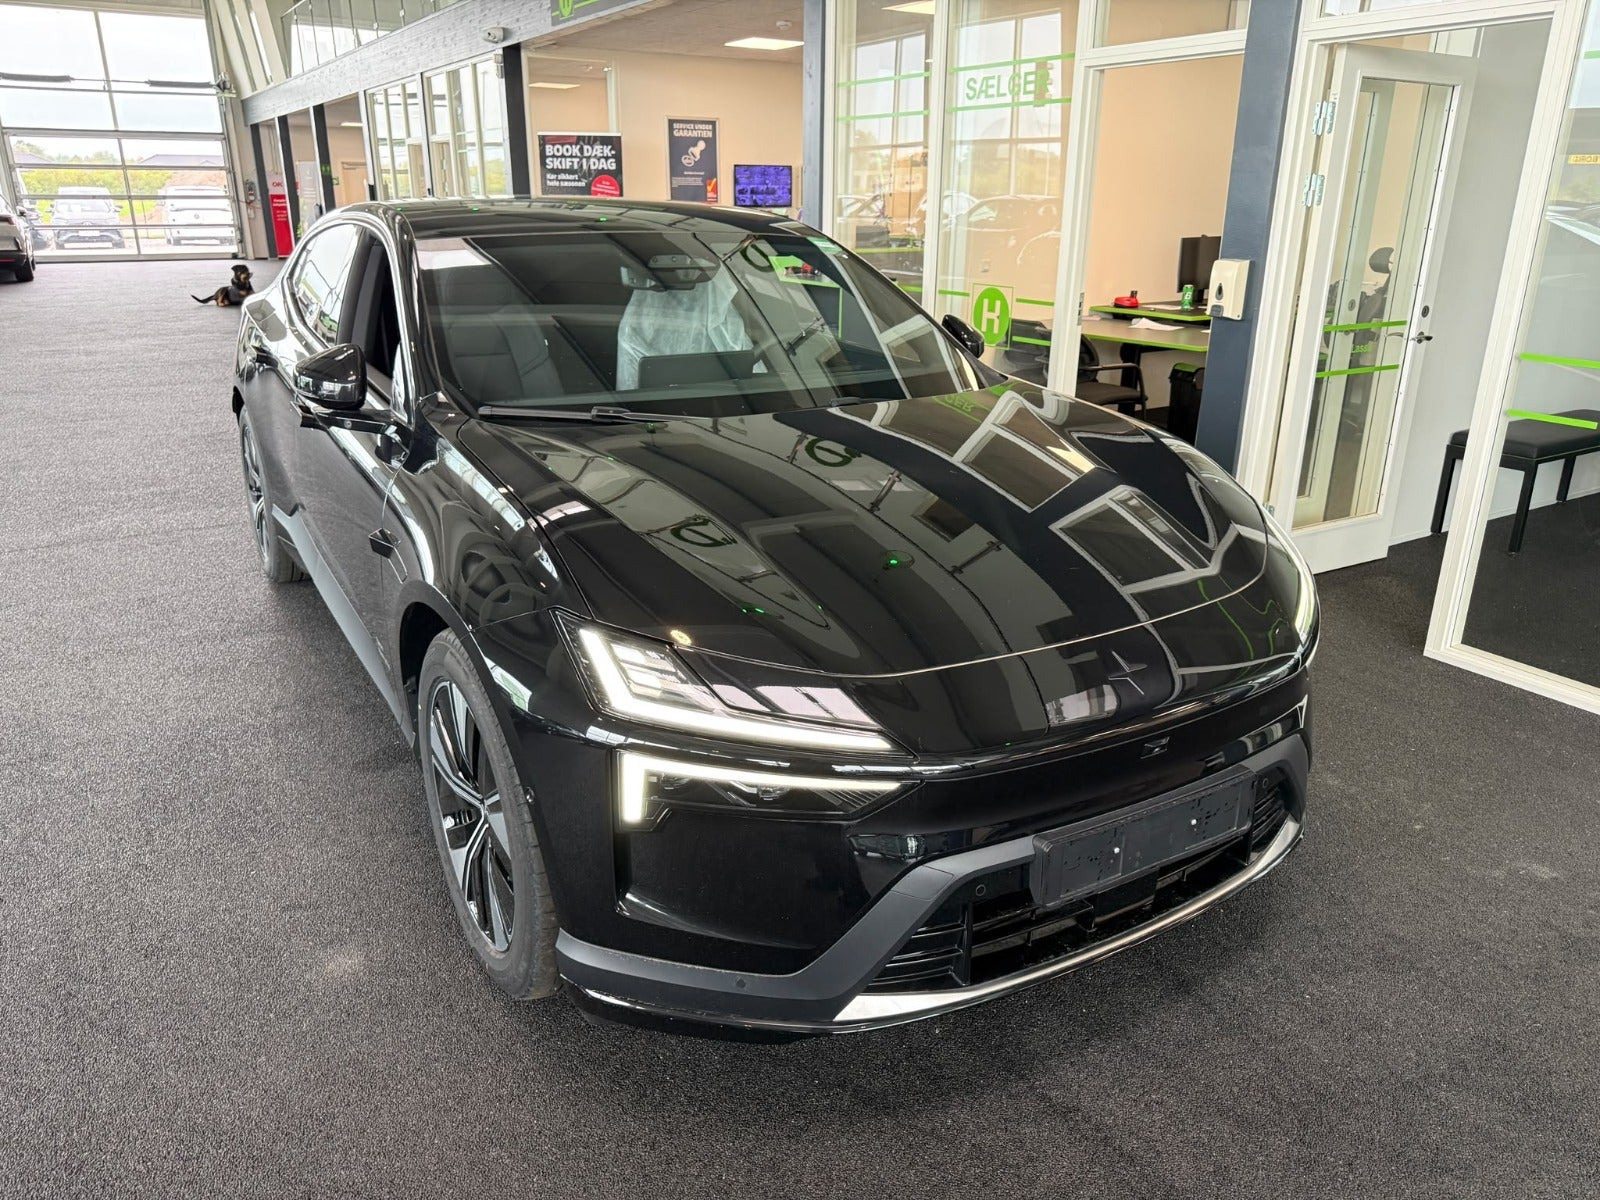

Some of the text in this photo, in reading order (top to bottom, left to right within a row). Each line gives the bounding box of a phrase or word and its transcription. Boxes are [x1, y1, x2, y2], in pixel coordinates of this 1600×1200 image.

[965, 69, 1050, 100] SÆLGER
[673, 129, 712, 137] GARANTIEN
[545, 144, 616, 157] BOOK DÆK-
[545, 157, 616, 170] SKIFT I DAG
